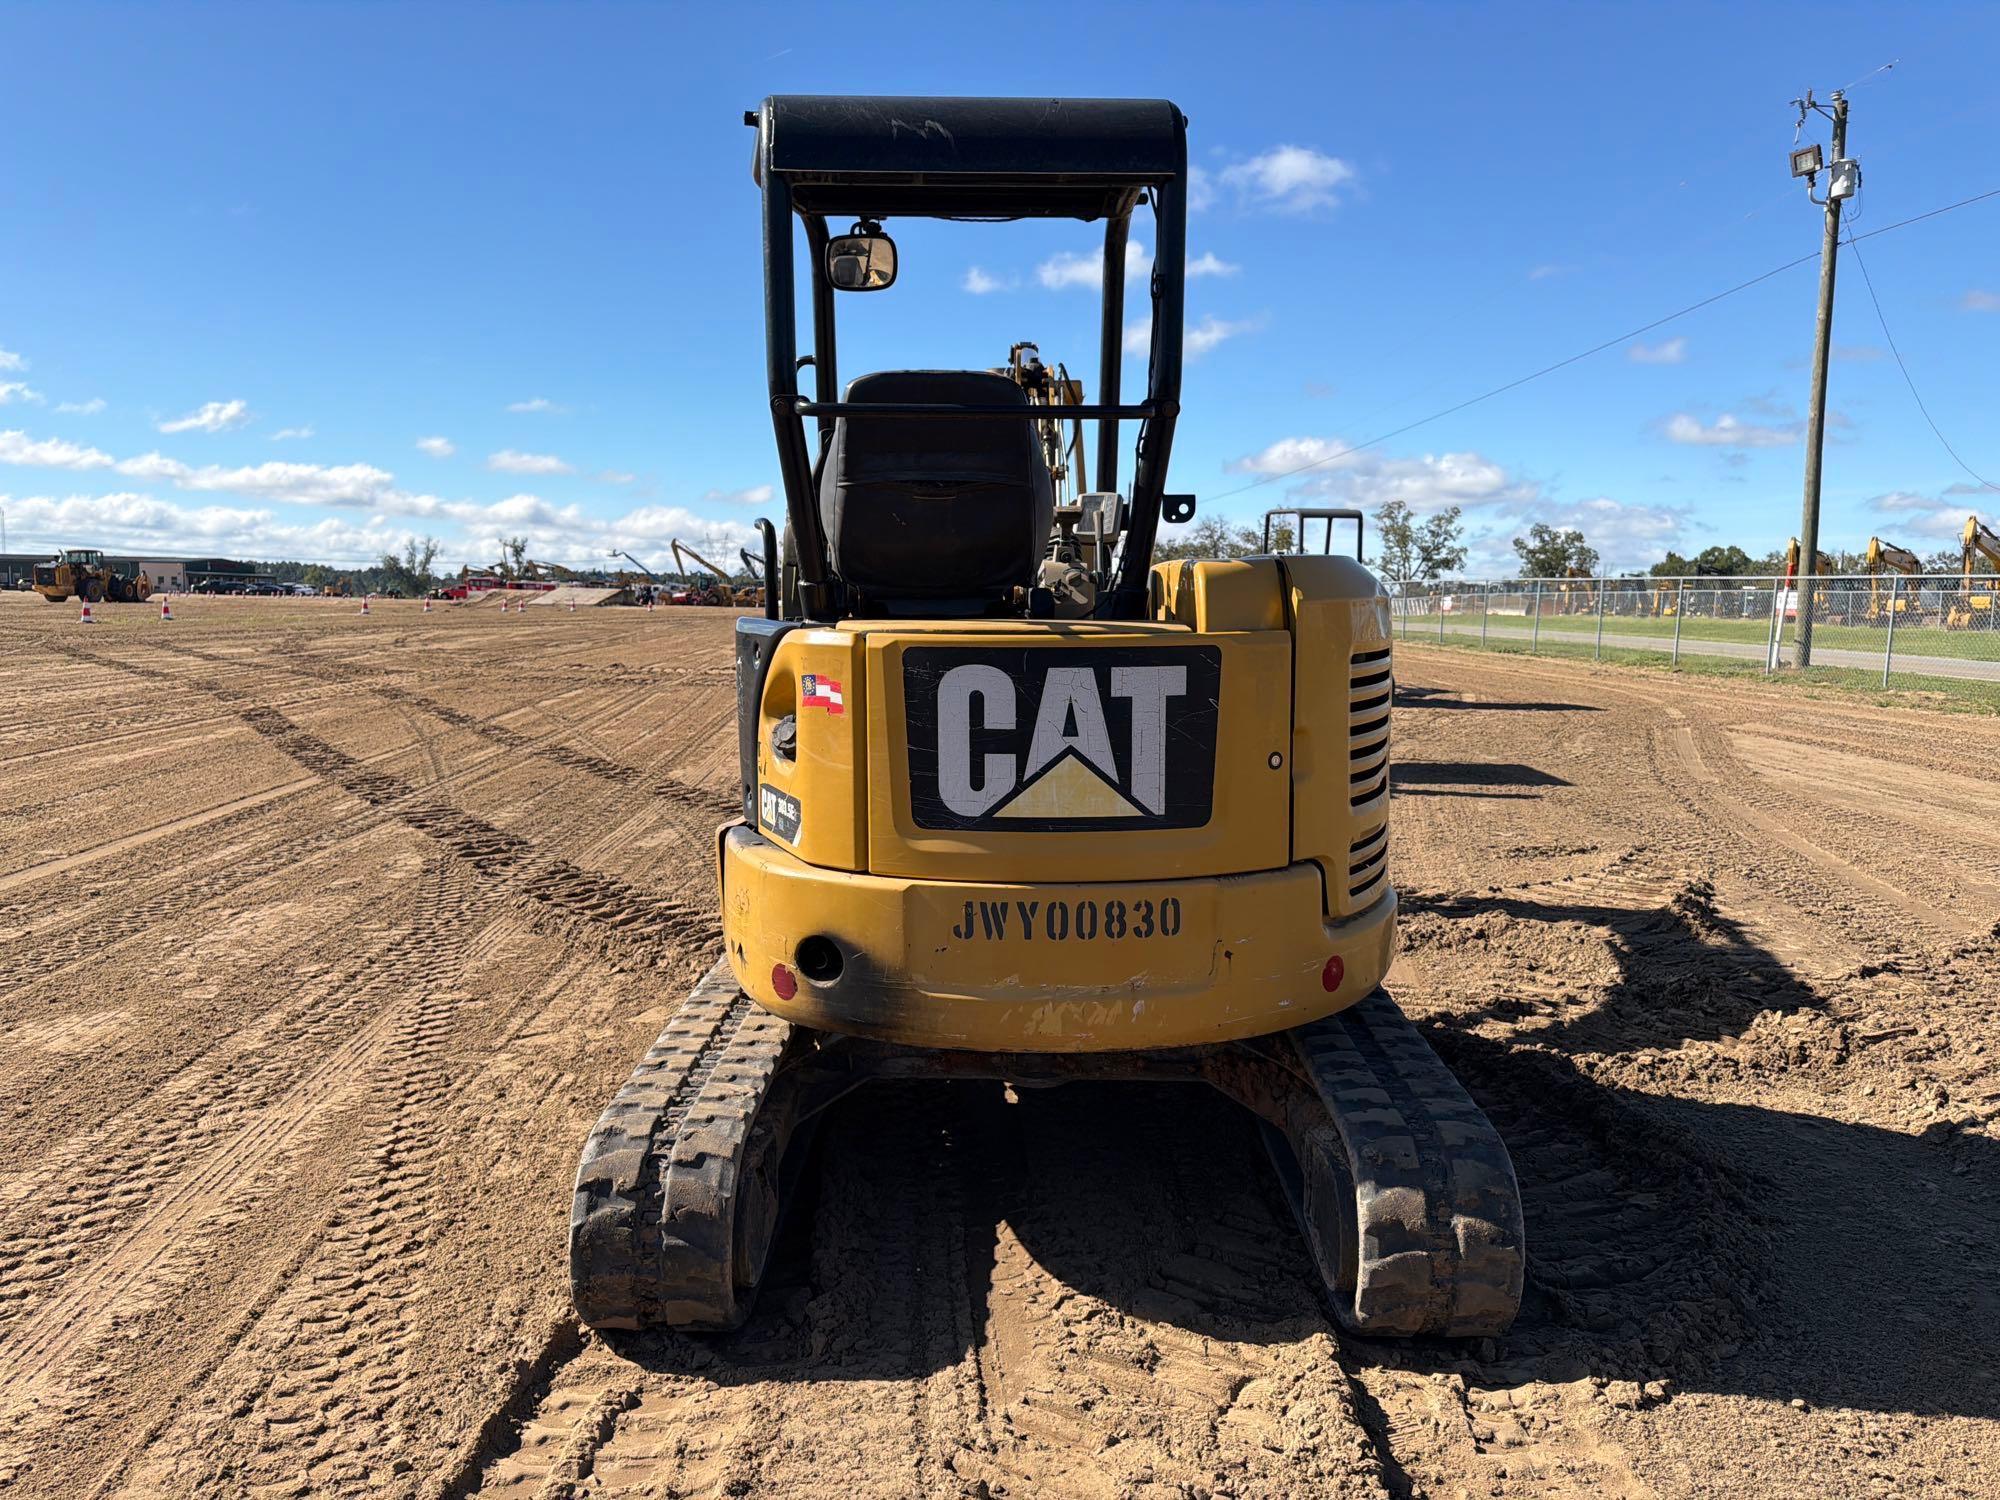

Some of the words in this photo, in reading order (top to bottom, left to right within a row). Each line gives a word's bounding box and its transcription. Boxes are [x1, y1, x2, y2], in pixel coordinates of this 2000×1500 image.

[937, 664, 1187, 817] CAT
[761, 787, 777, 826] CAT
[953, 897, 1181, 941] JWY00830
